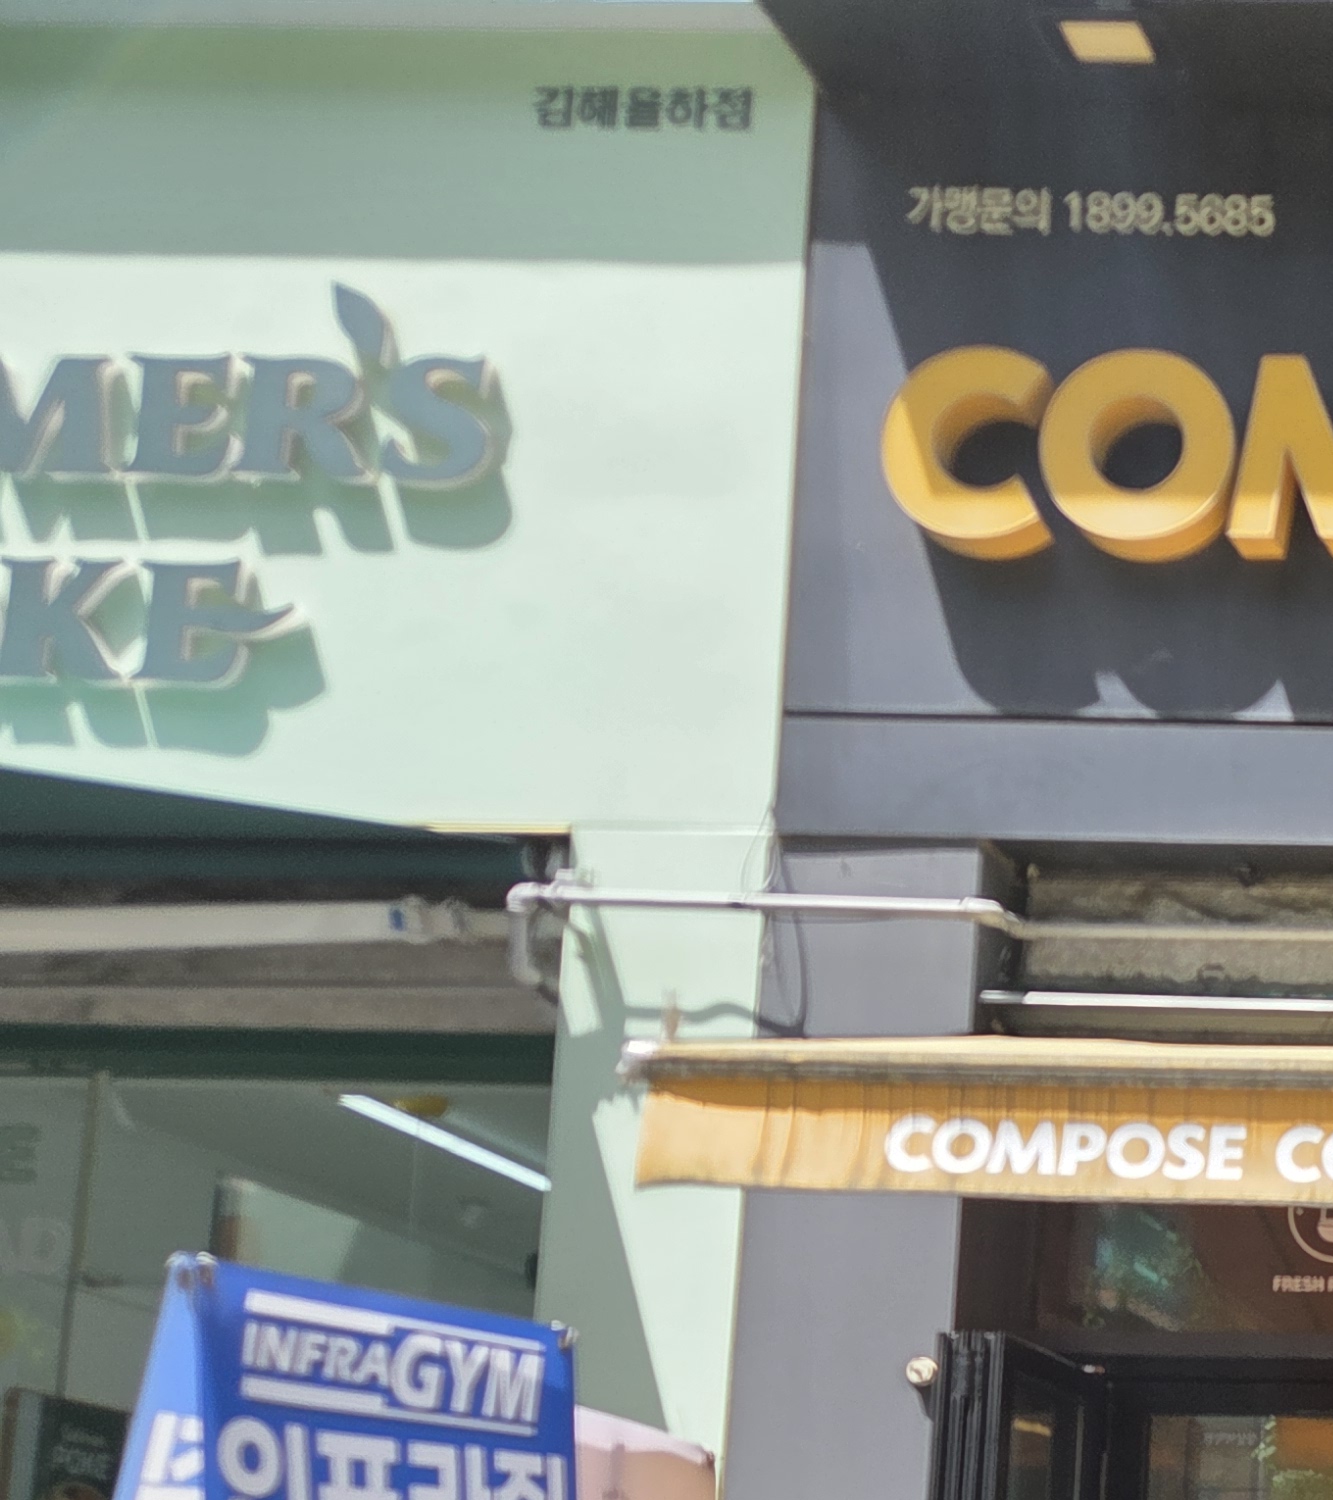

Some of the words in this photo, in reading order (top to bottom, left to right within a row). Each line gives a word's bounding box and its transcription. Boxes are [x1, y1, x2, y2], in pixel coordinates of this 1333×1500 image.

[532, 86, 755, 132] 김해율하점
[906, 185, 1052, 237] 가맹문의
[1062, 190, 1276, 238] 1899.5685
[884, 1113, 1247, 1183] COMPOSE
[1272, 1275, 1324, 1292] FRESH
